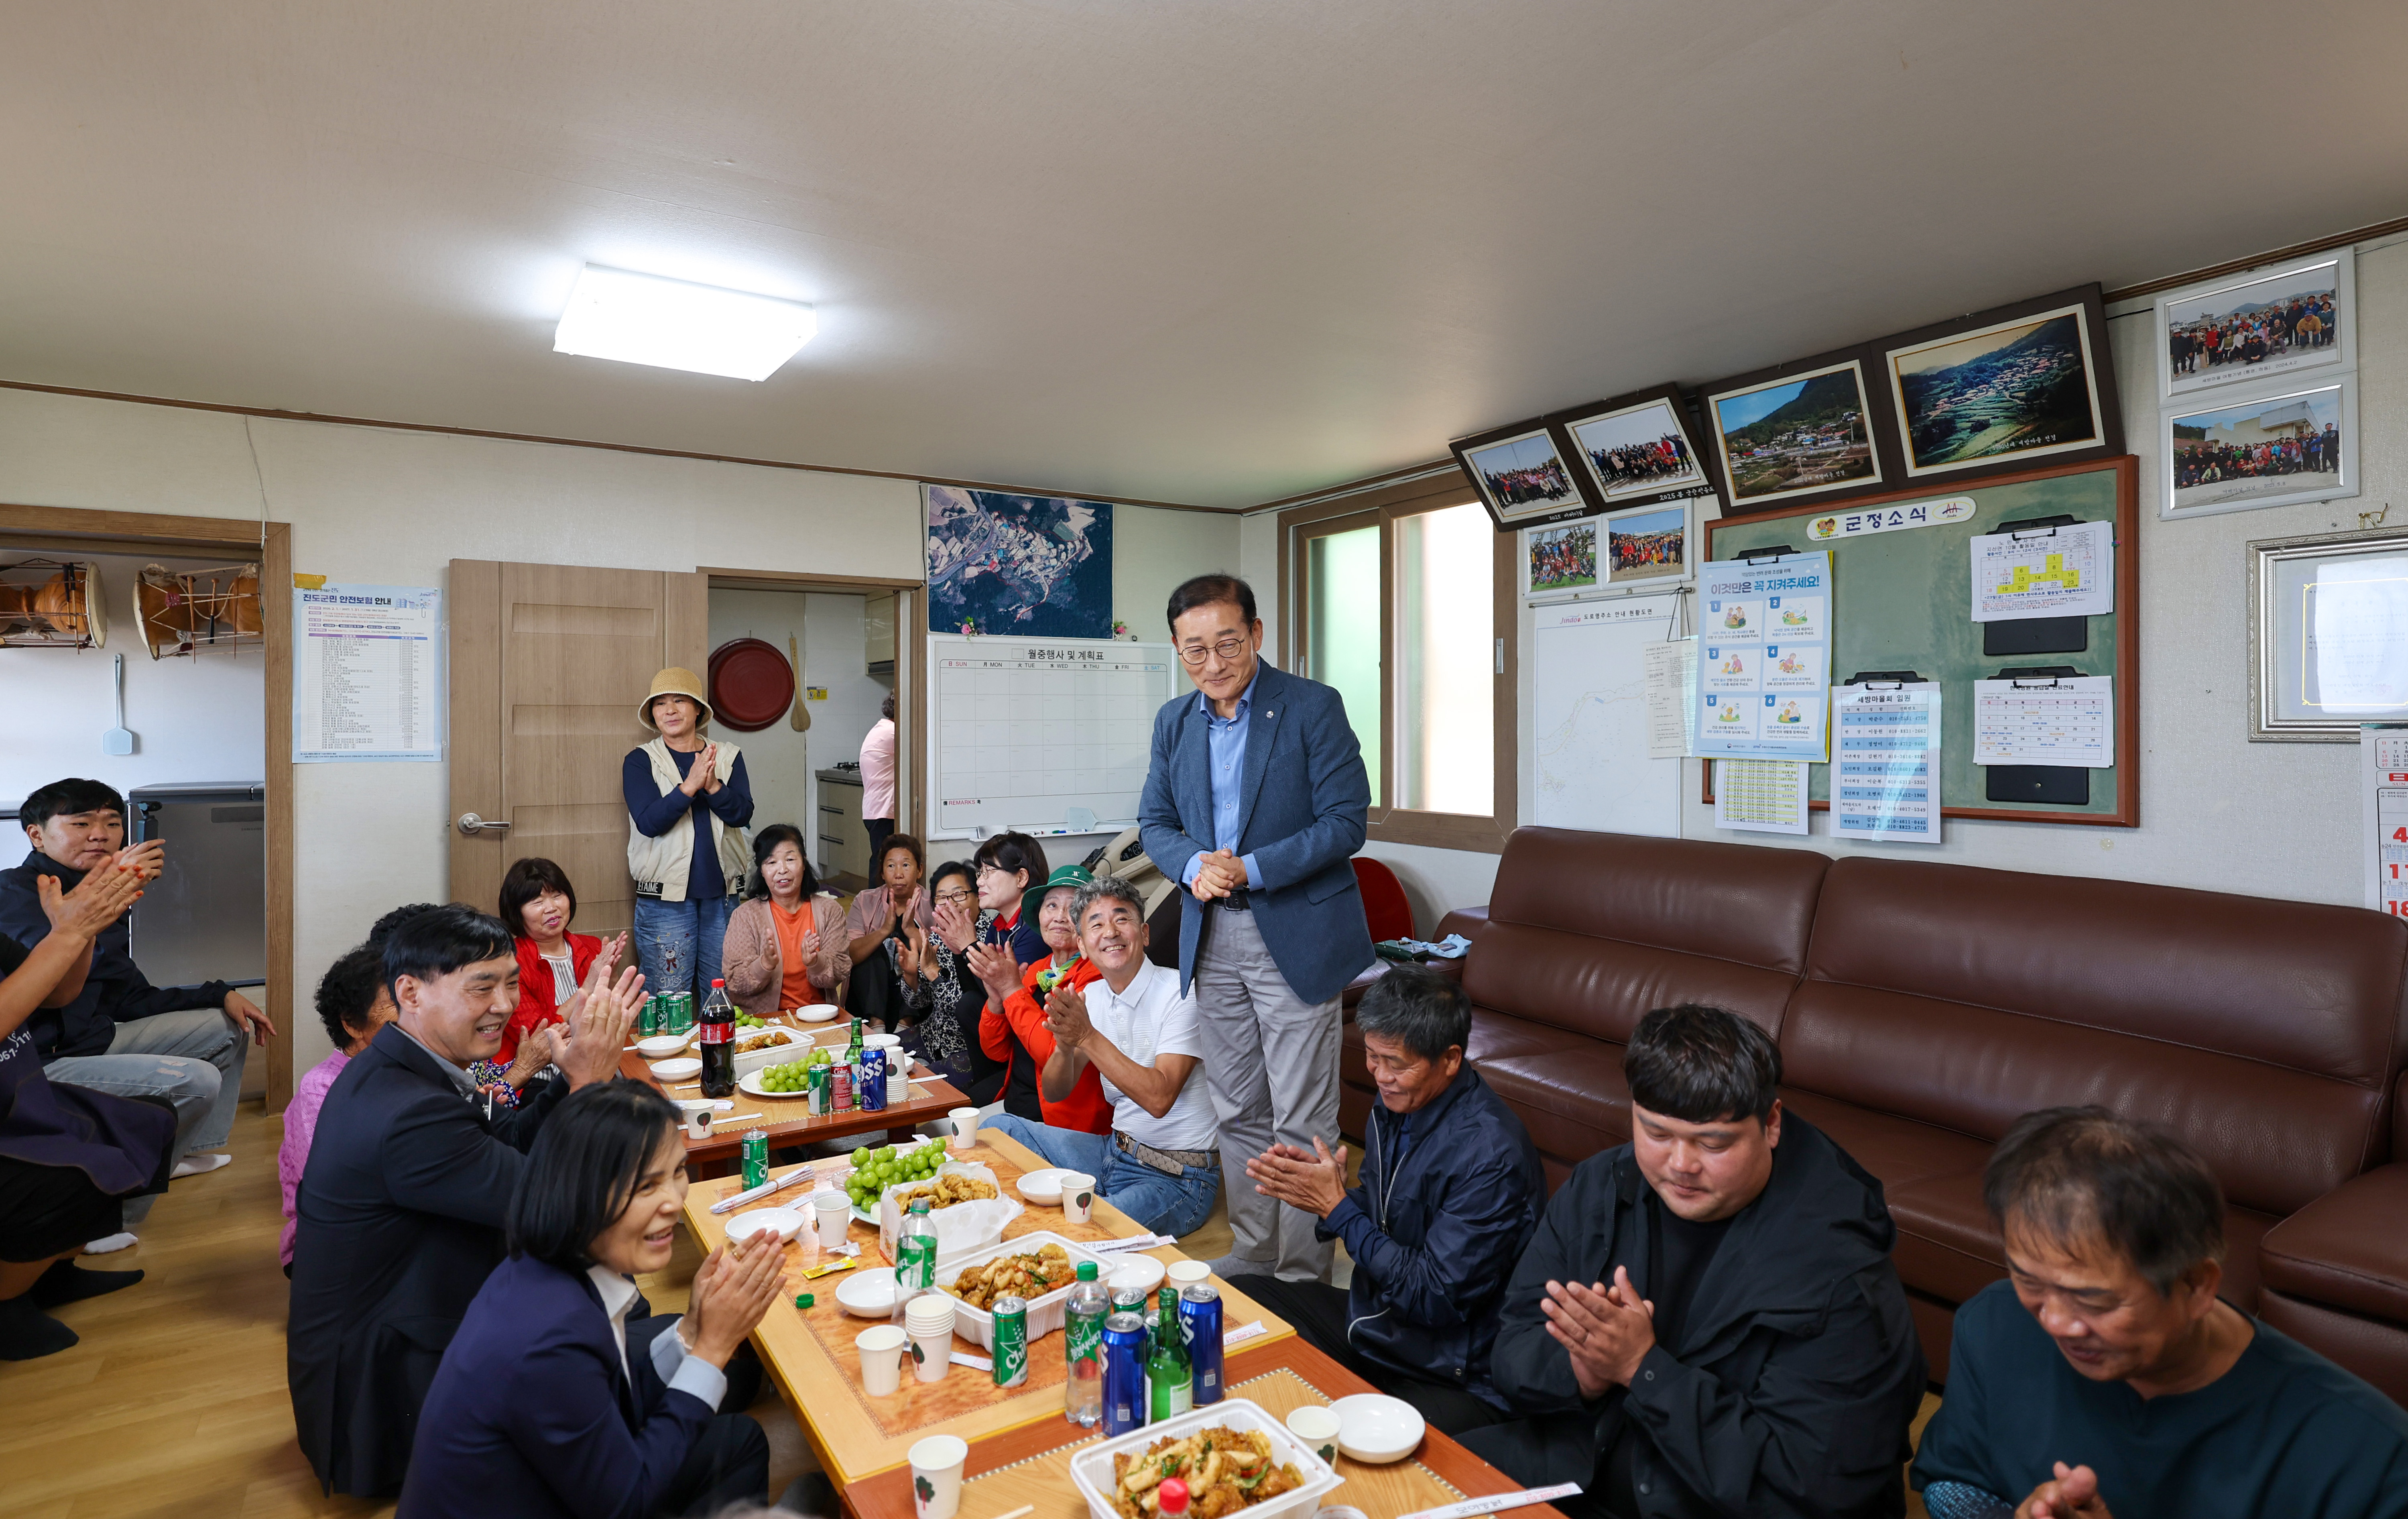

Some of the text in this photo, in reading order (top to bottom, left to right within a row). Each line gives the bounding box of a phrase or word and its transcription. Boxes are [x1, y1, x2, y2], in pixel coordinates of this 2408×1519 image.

[1846, 507, 1926, 531] 군정소식
[1711, 576, 1819, 595] 이것만은 꼭 지켜주세요!
[303, 594, 337, 603] 진도군민
[340, 596, 372, 604] 안전보험
[1560, 616, 1577, 624] Jindo
[1028, 649, 1104, 660] 월중행사 및 계획표
[2393, 827, 2408, 843] 4
